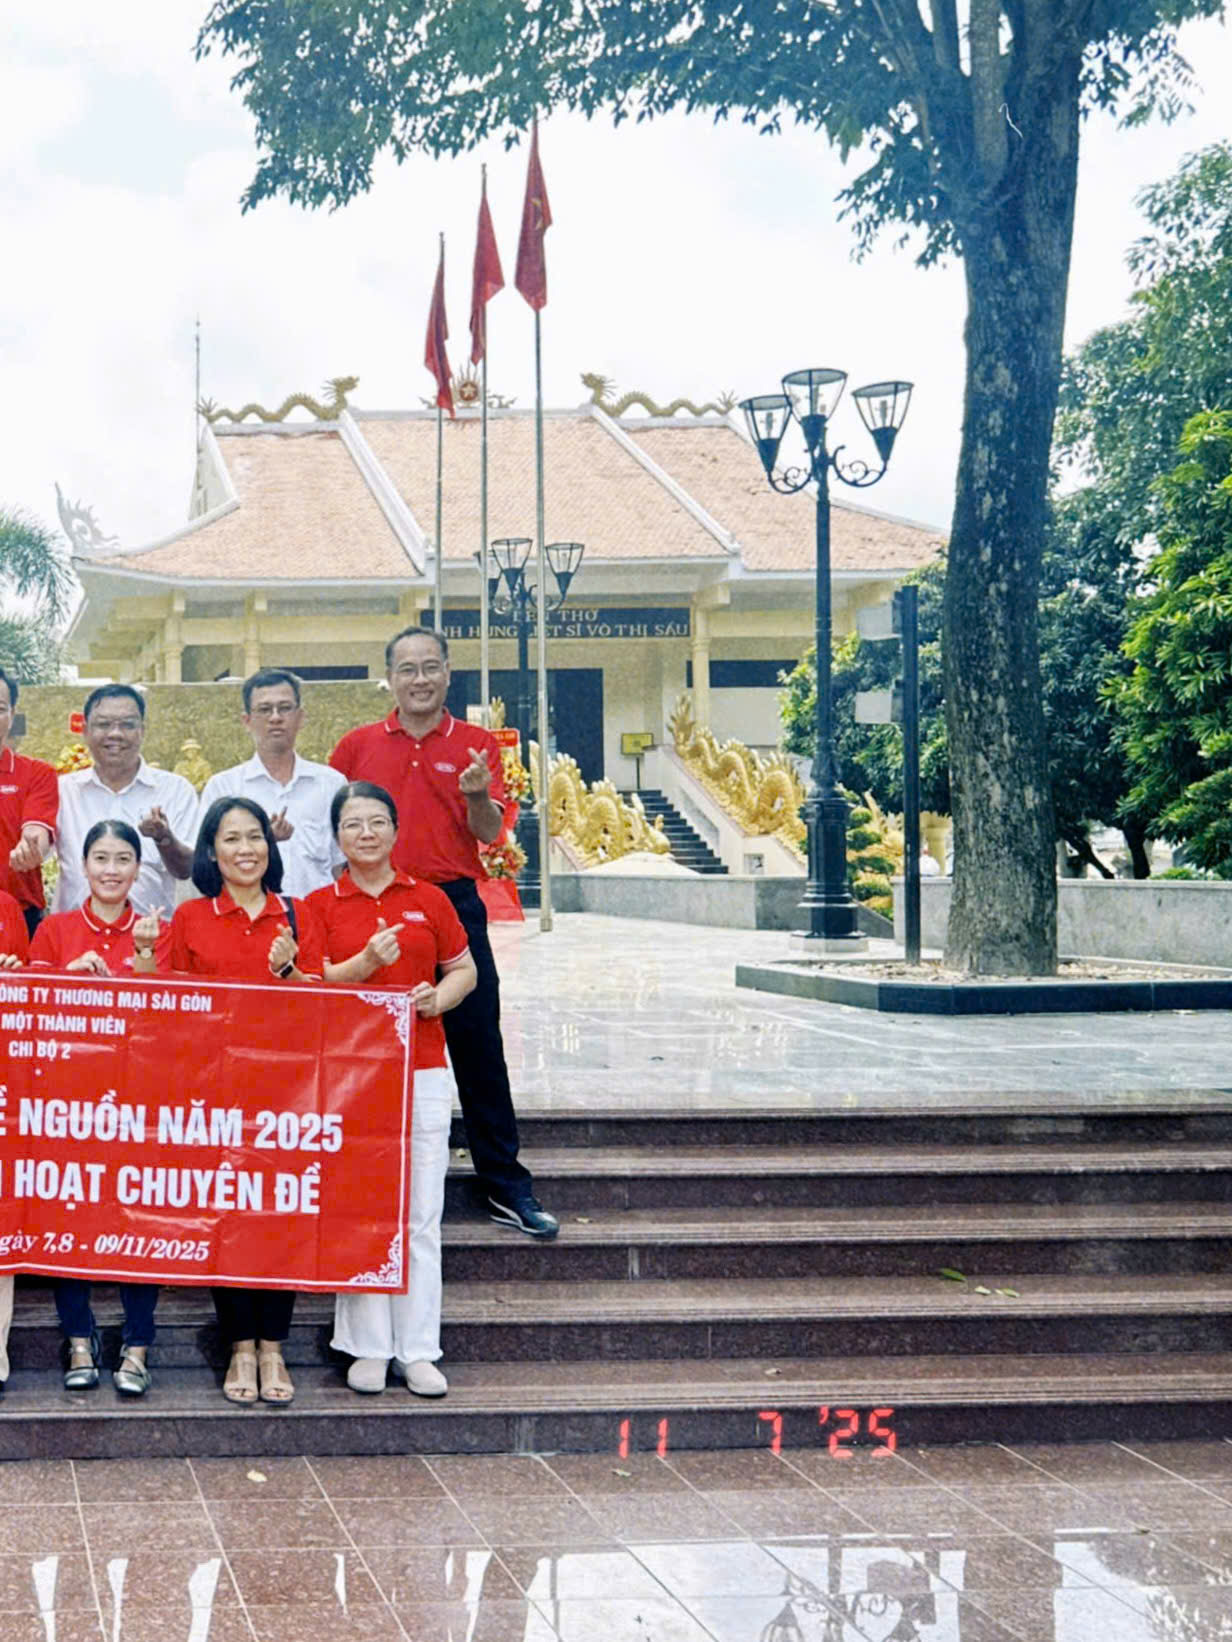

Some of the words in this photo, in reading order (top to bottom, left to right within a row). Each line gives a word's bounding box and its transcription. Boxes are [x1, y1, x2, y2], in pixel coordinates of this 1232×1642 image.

[614, 623, 648, 638] THỊ
[655, 621, 688, 636] SÁU
[33, 987, 49, 1004] TY
[53, 987, 114, 1008] THƯƠNG
[118, 992, 147, 1012] MẠI
[151, 990, 176, 1011] SÀI
[180, 992, 212, 1012] GÒN
[1, 1011, 34, 1034] MỘT
[36, 1012, 86, 1033] THÀNH
[90, 1014, 126, 1035] VIÊN
[8, 1040, 33, 1057] CHI
[37, 1039, 58, 1061] BỘ
[61, 1043, 71, 1060] 2
[19, 1089, 146, 1143] NGUỒN
[157, 1098, 243, 1147] NĂM
[254, 1110, 343, 1152] 2025
[14, 1159, 106, 1210] HOẠT
[116, 1161, 263, 1211] CHUYÊN
[274, 1161, 321, 1214] ĐỀ
[42, 1231, 75, 1254] 7,8
[94, 1233, 210, 1262] 09/11/2025
